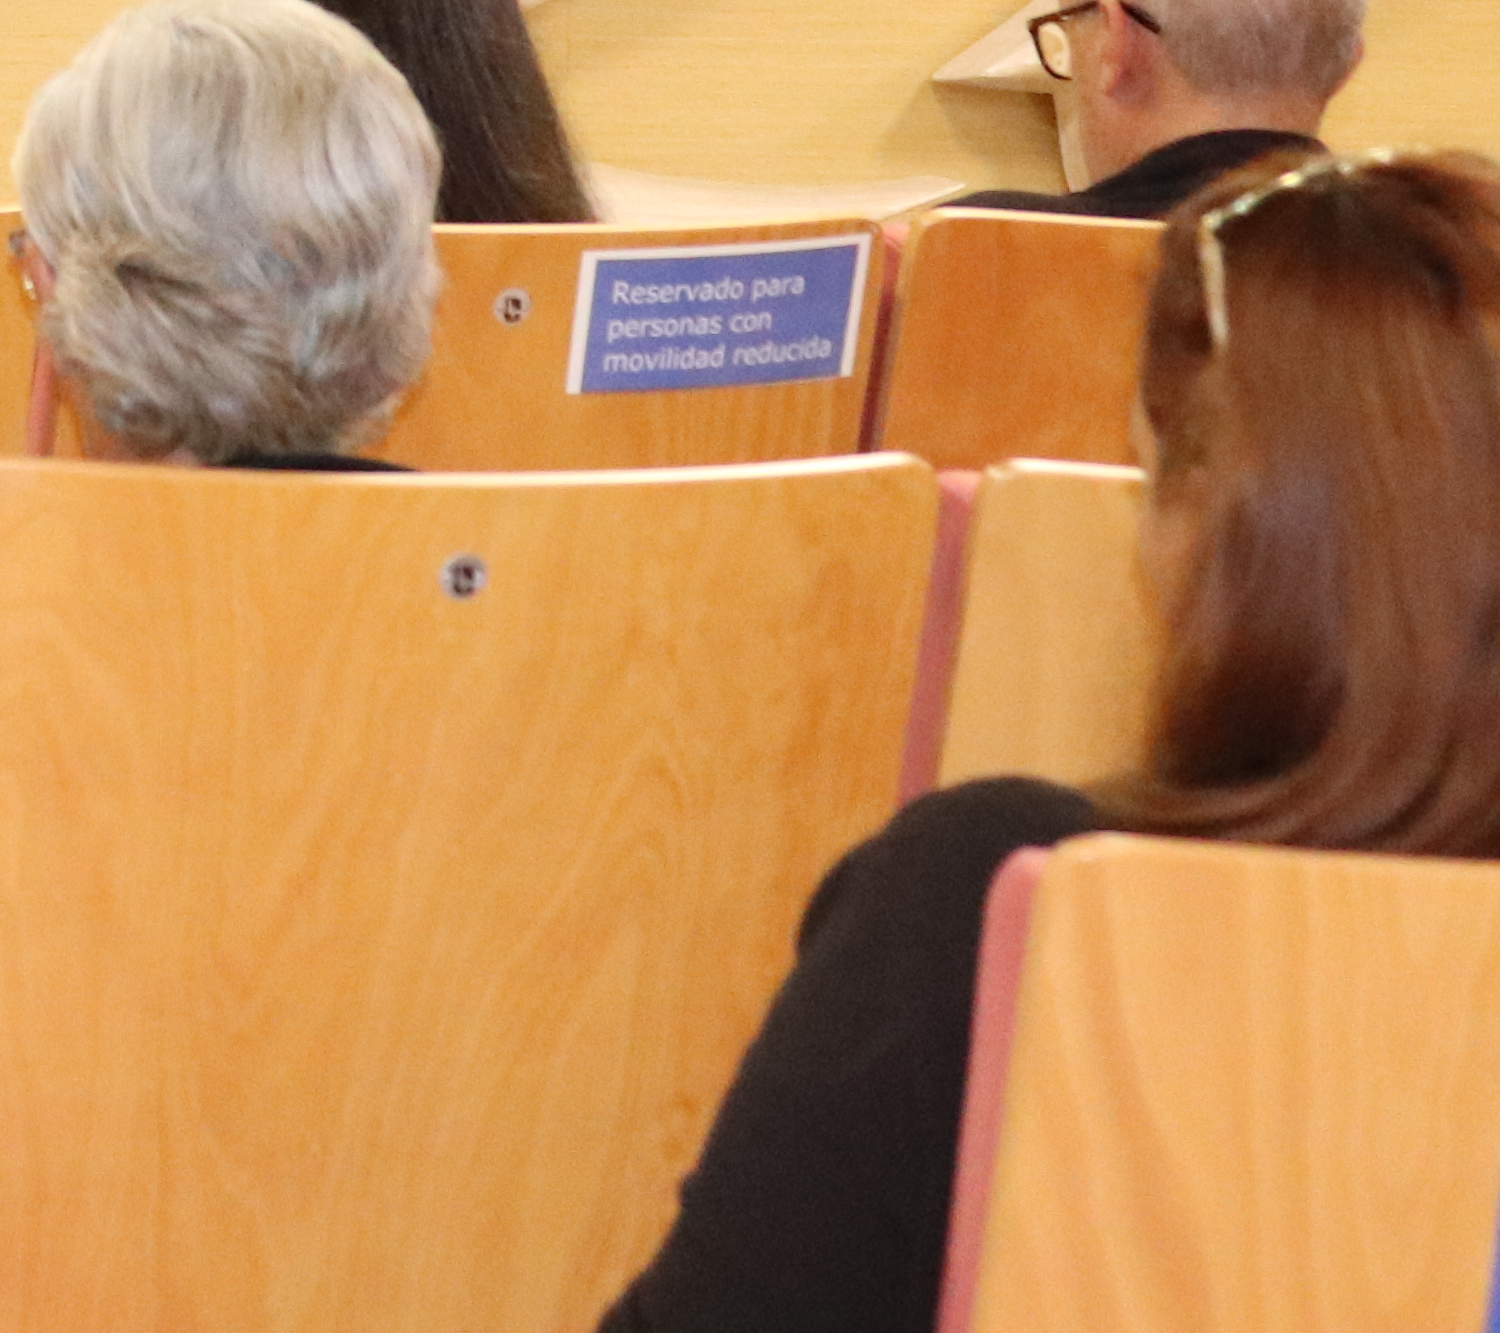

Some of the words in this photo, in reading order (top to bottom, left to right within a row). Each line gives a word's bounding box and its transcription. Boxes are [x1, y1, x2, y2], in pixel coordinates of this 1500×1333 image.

[612, 277, 744, 305] Reservado
[752, 275, 805, 303] para
[607, 310, 722, 343] personas
[729, 308, 772, 333] con
[603, 344, 724, 373] movilidad
[733, 336, 831, 366] reducida
